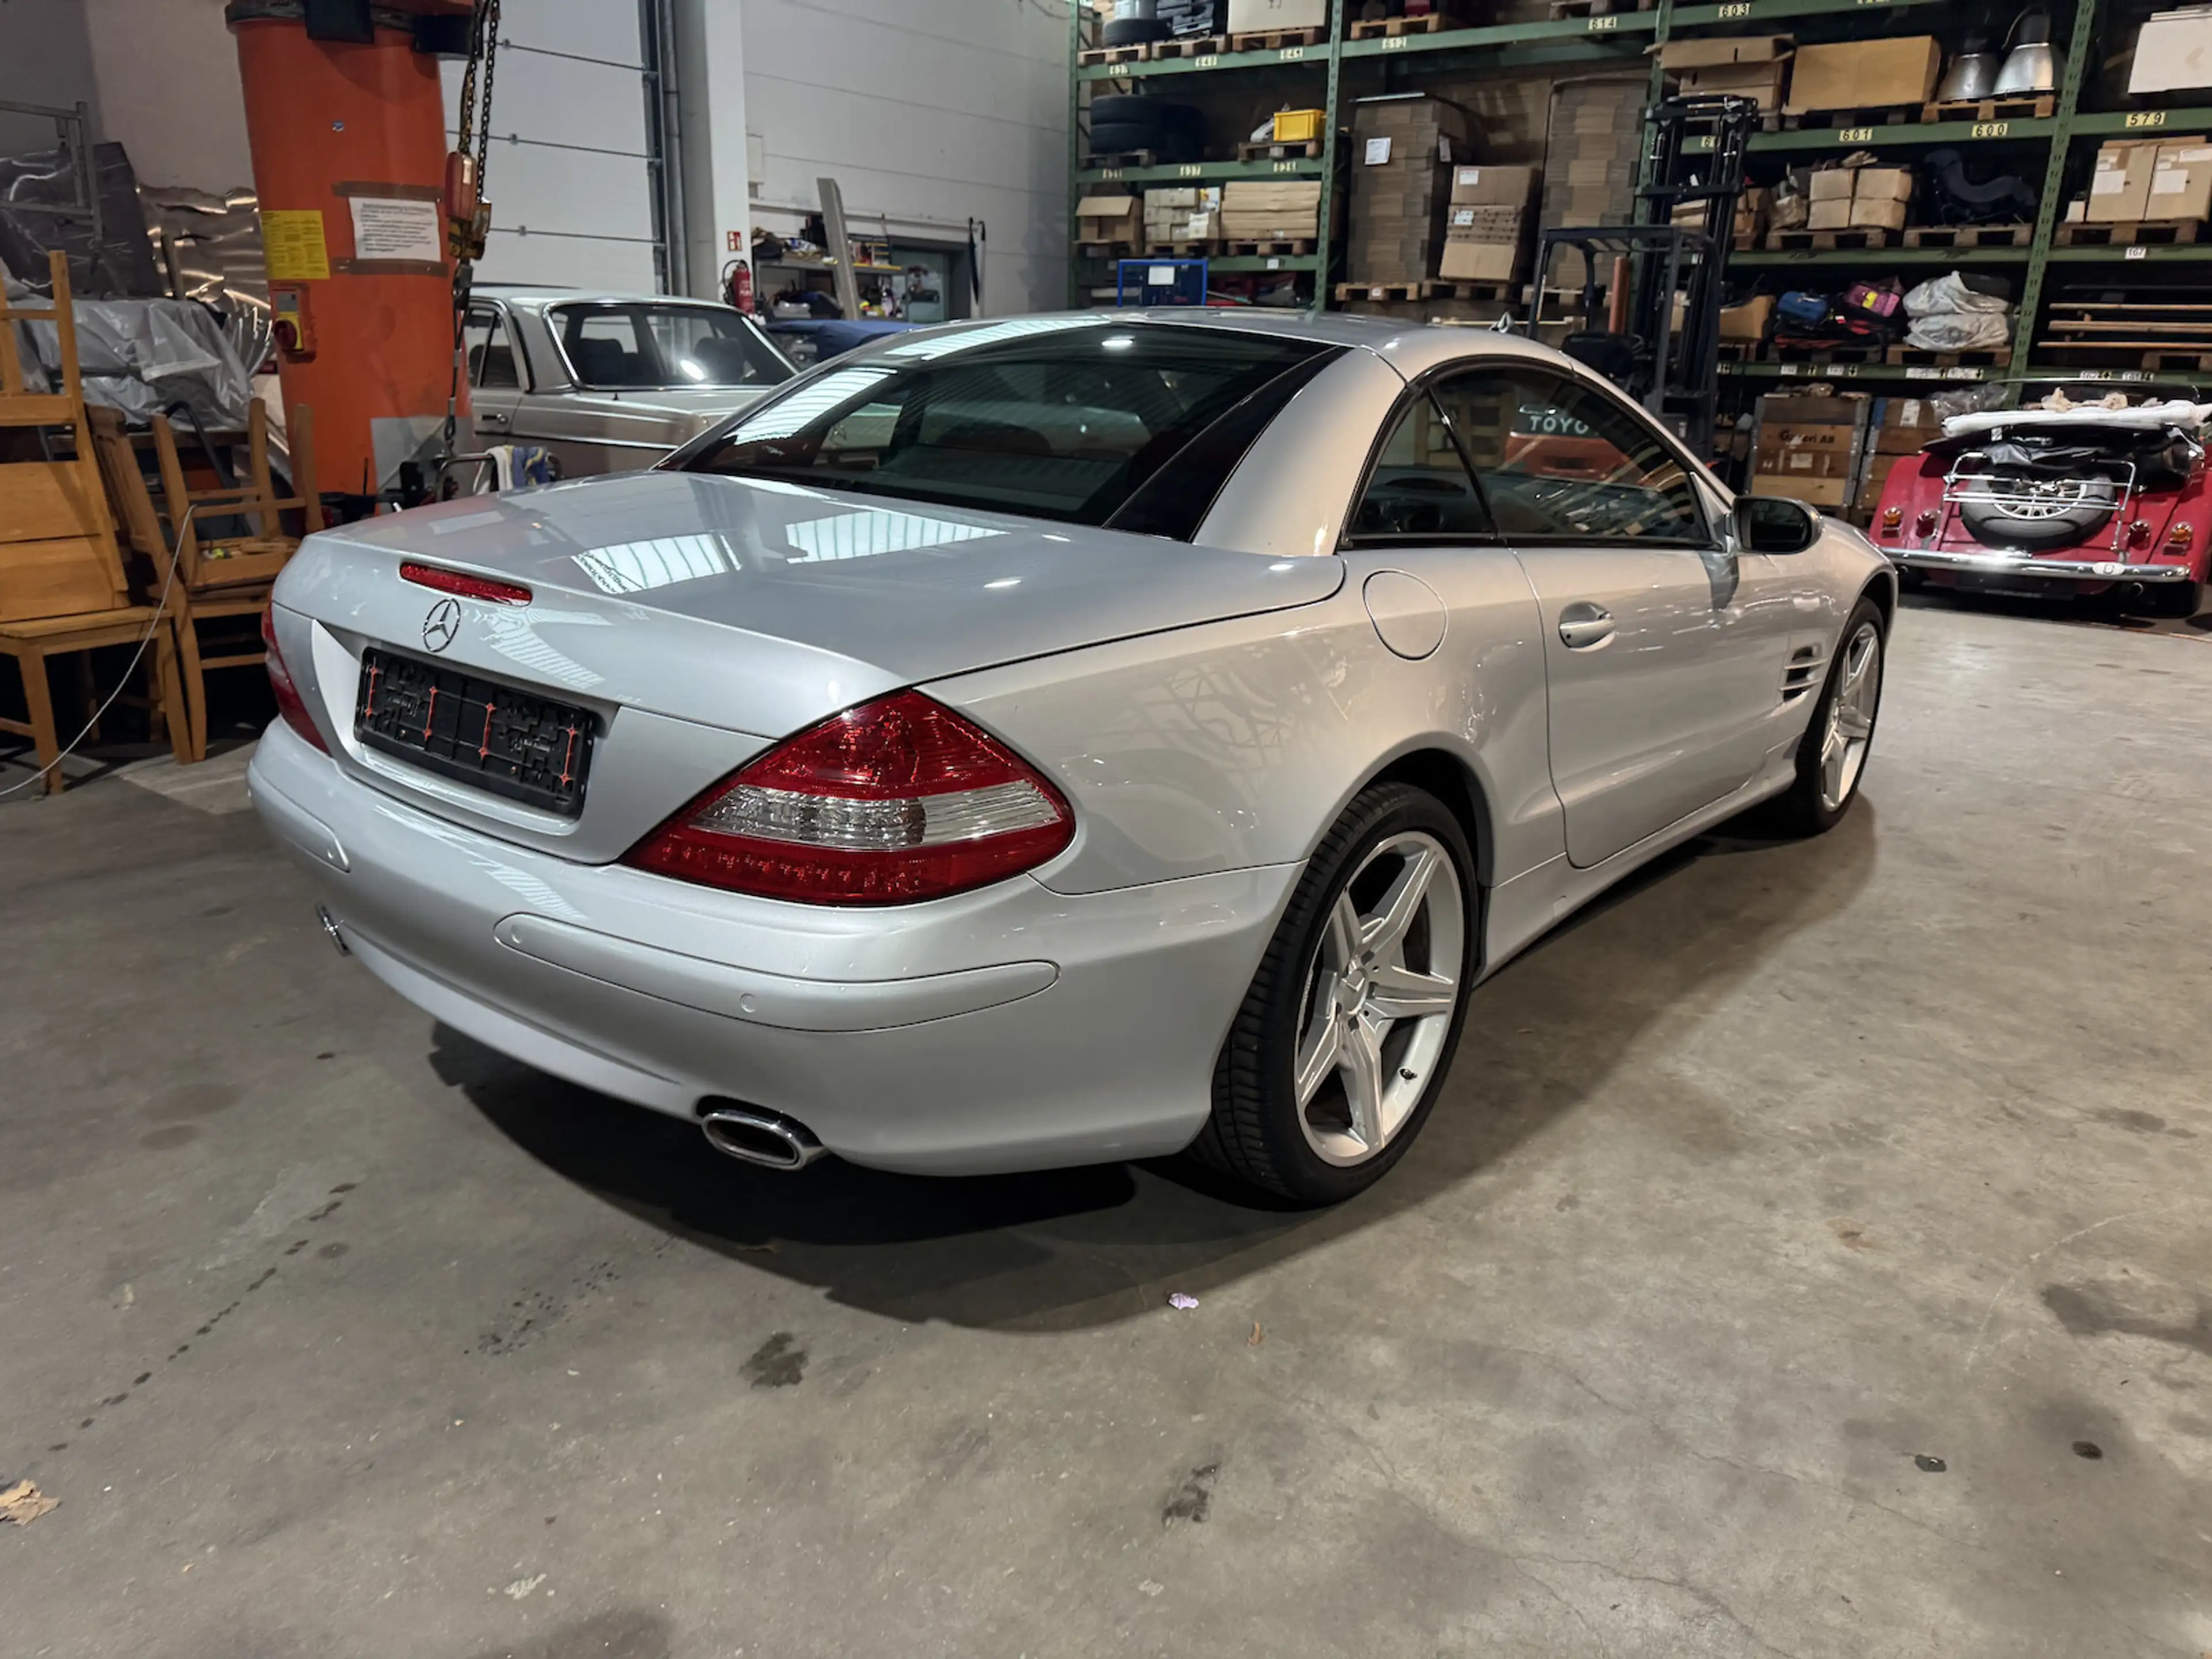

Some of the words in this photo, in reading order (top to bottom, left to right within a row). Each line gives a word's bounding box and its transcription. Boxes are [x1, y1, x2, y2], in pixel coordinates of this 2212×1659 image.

[1722, 4, 1747, 18] 603
[2130, 111, 2162, 126] 579
[1842, 129, 1869, 141] 601
[1976, 124, 2005, 137] 600
